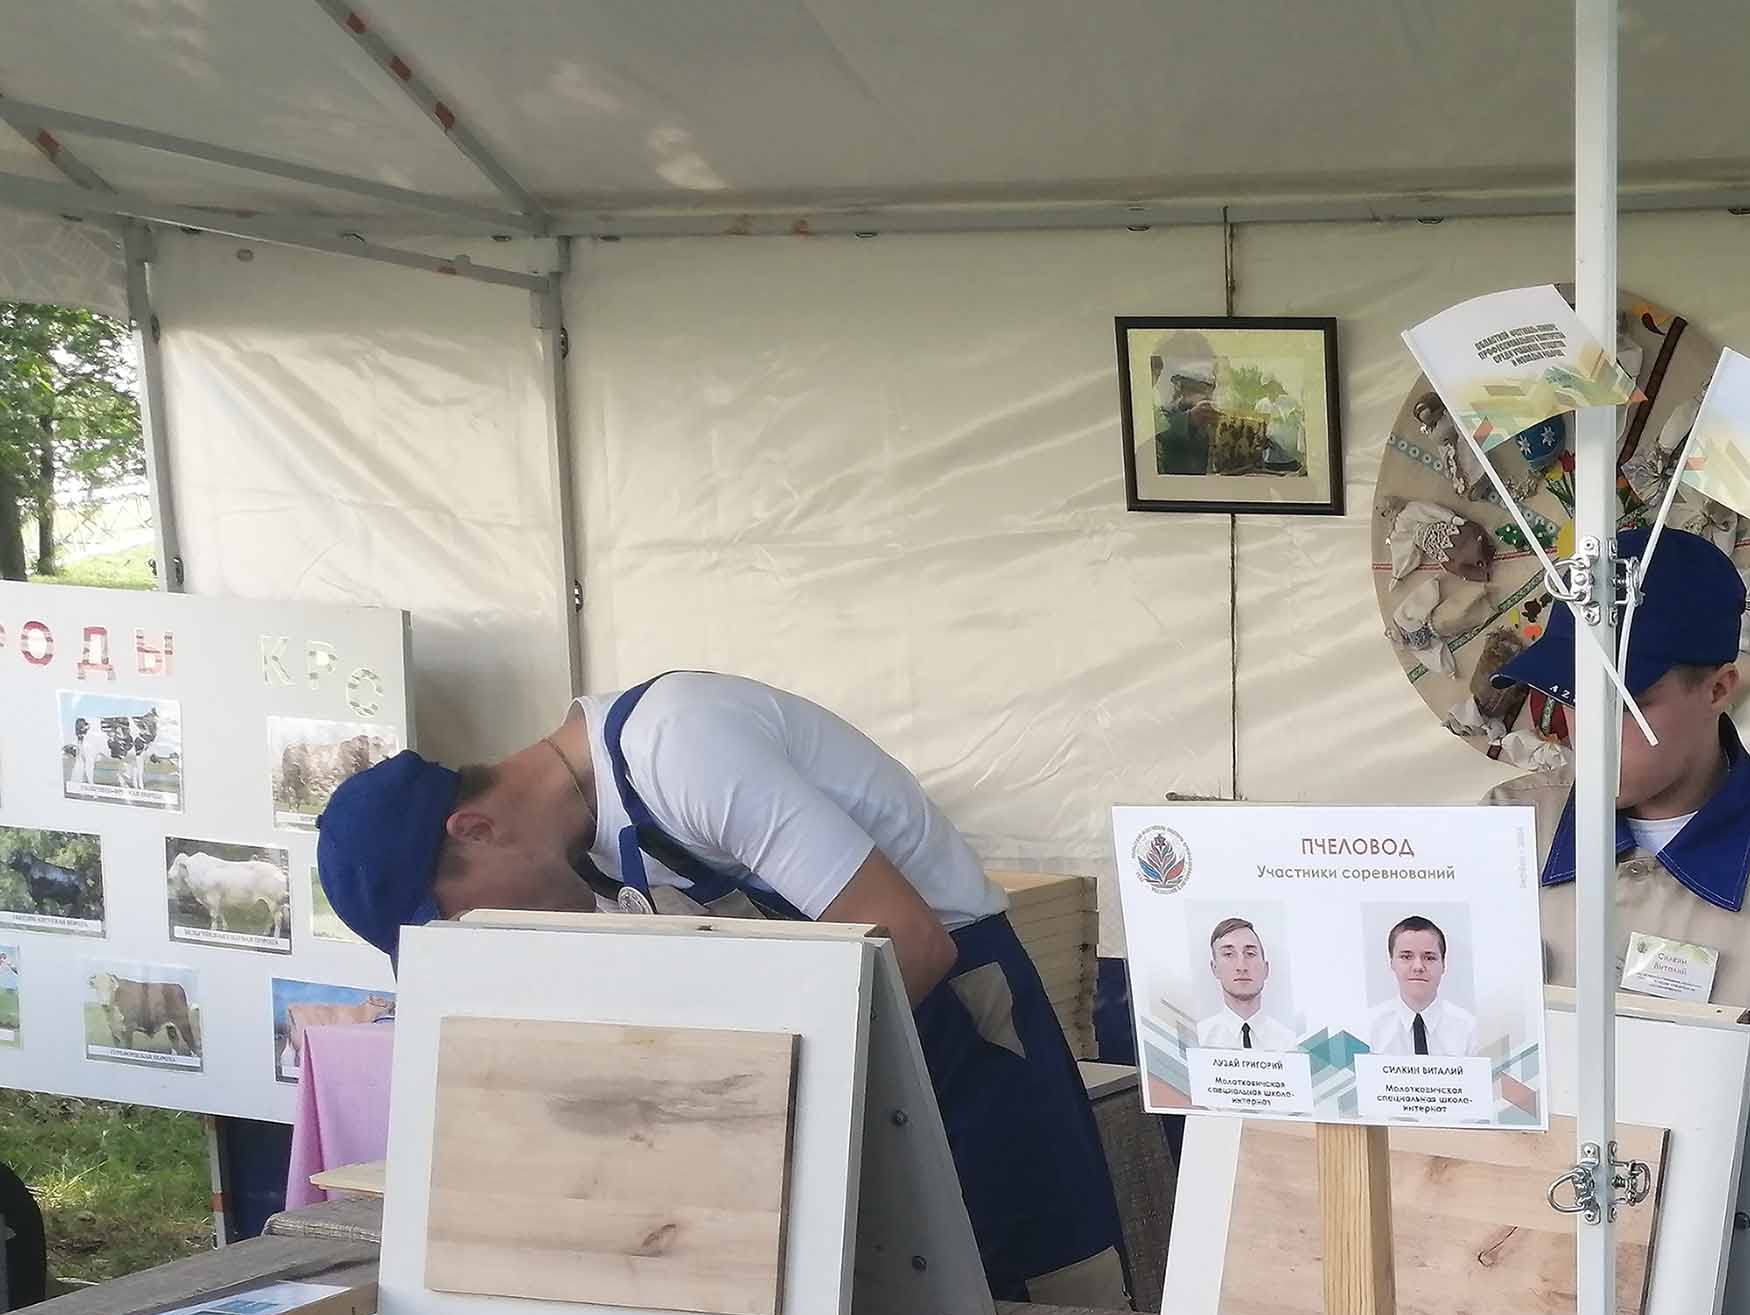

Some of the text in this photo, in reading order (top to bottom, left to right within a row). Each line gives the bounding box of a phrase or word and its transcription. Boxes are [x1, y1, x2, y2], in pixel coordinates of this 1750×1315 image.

[0, 619, 175, 681] ОДЫ
[1301, 837, 1415, 857] ПЧЕЛОВОД
[1256, 865, 1455, 882] Участники соревнований
[1241, 1060, 1284, 1070] ГРИГОРИЙ
[1382, 1065, 1464, 1076] СИЛКИН ВИТАЛИЙ
[1215, 1076, 1286, 1089] Молотковичская
[1385, 1084, 1463, 1095] Молотковичская
[1376, 1094, 1437, 1103] специальная
[1402, 1105, 1448, 1114] интернат
